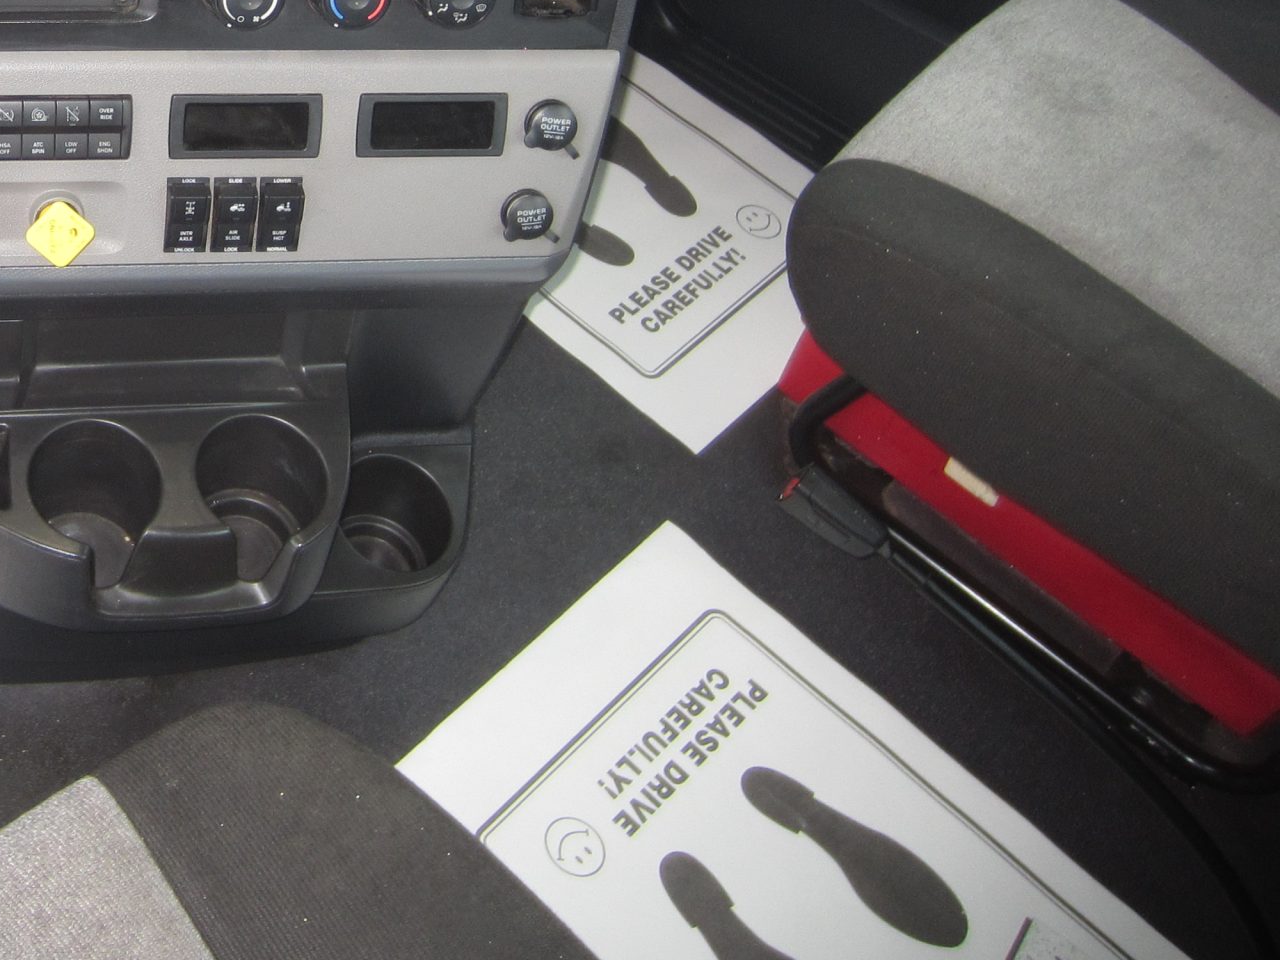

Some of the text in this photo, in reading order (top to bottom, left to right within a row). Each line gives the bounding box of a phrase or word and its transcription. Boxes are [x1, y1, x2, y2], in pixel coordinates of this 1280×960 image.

[540, 123, 570, 132] OUTLET
[541, 116, 572, 126] POWER
[516, 207, 547, 217] POWER
[516, 214, 546, 224] OUTLET
[608, 225, 733, 324] PLEASE DRIVE
[640, 247, 747, 333] CAREFULLY!
[597, 668, 730, 800] CAREFULLY!
[612, 678, 769, 837] PLEASE DRIVE
